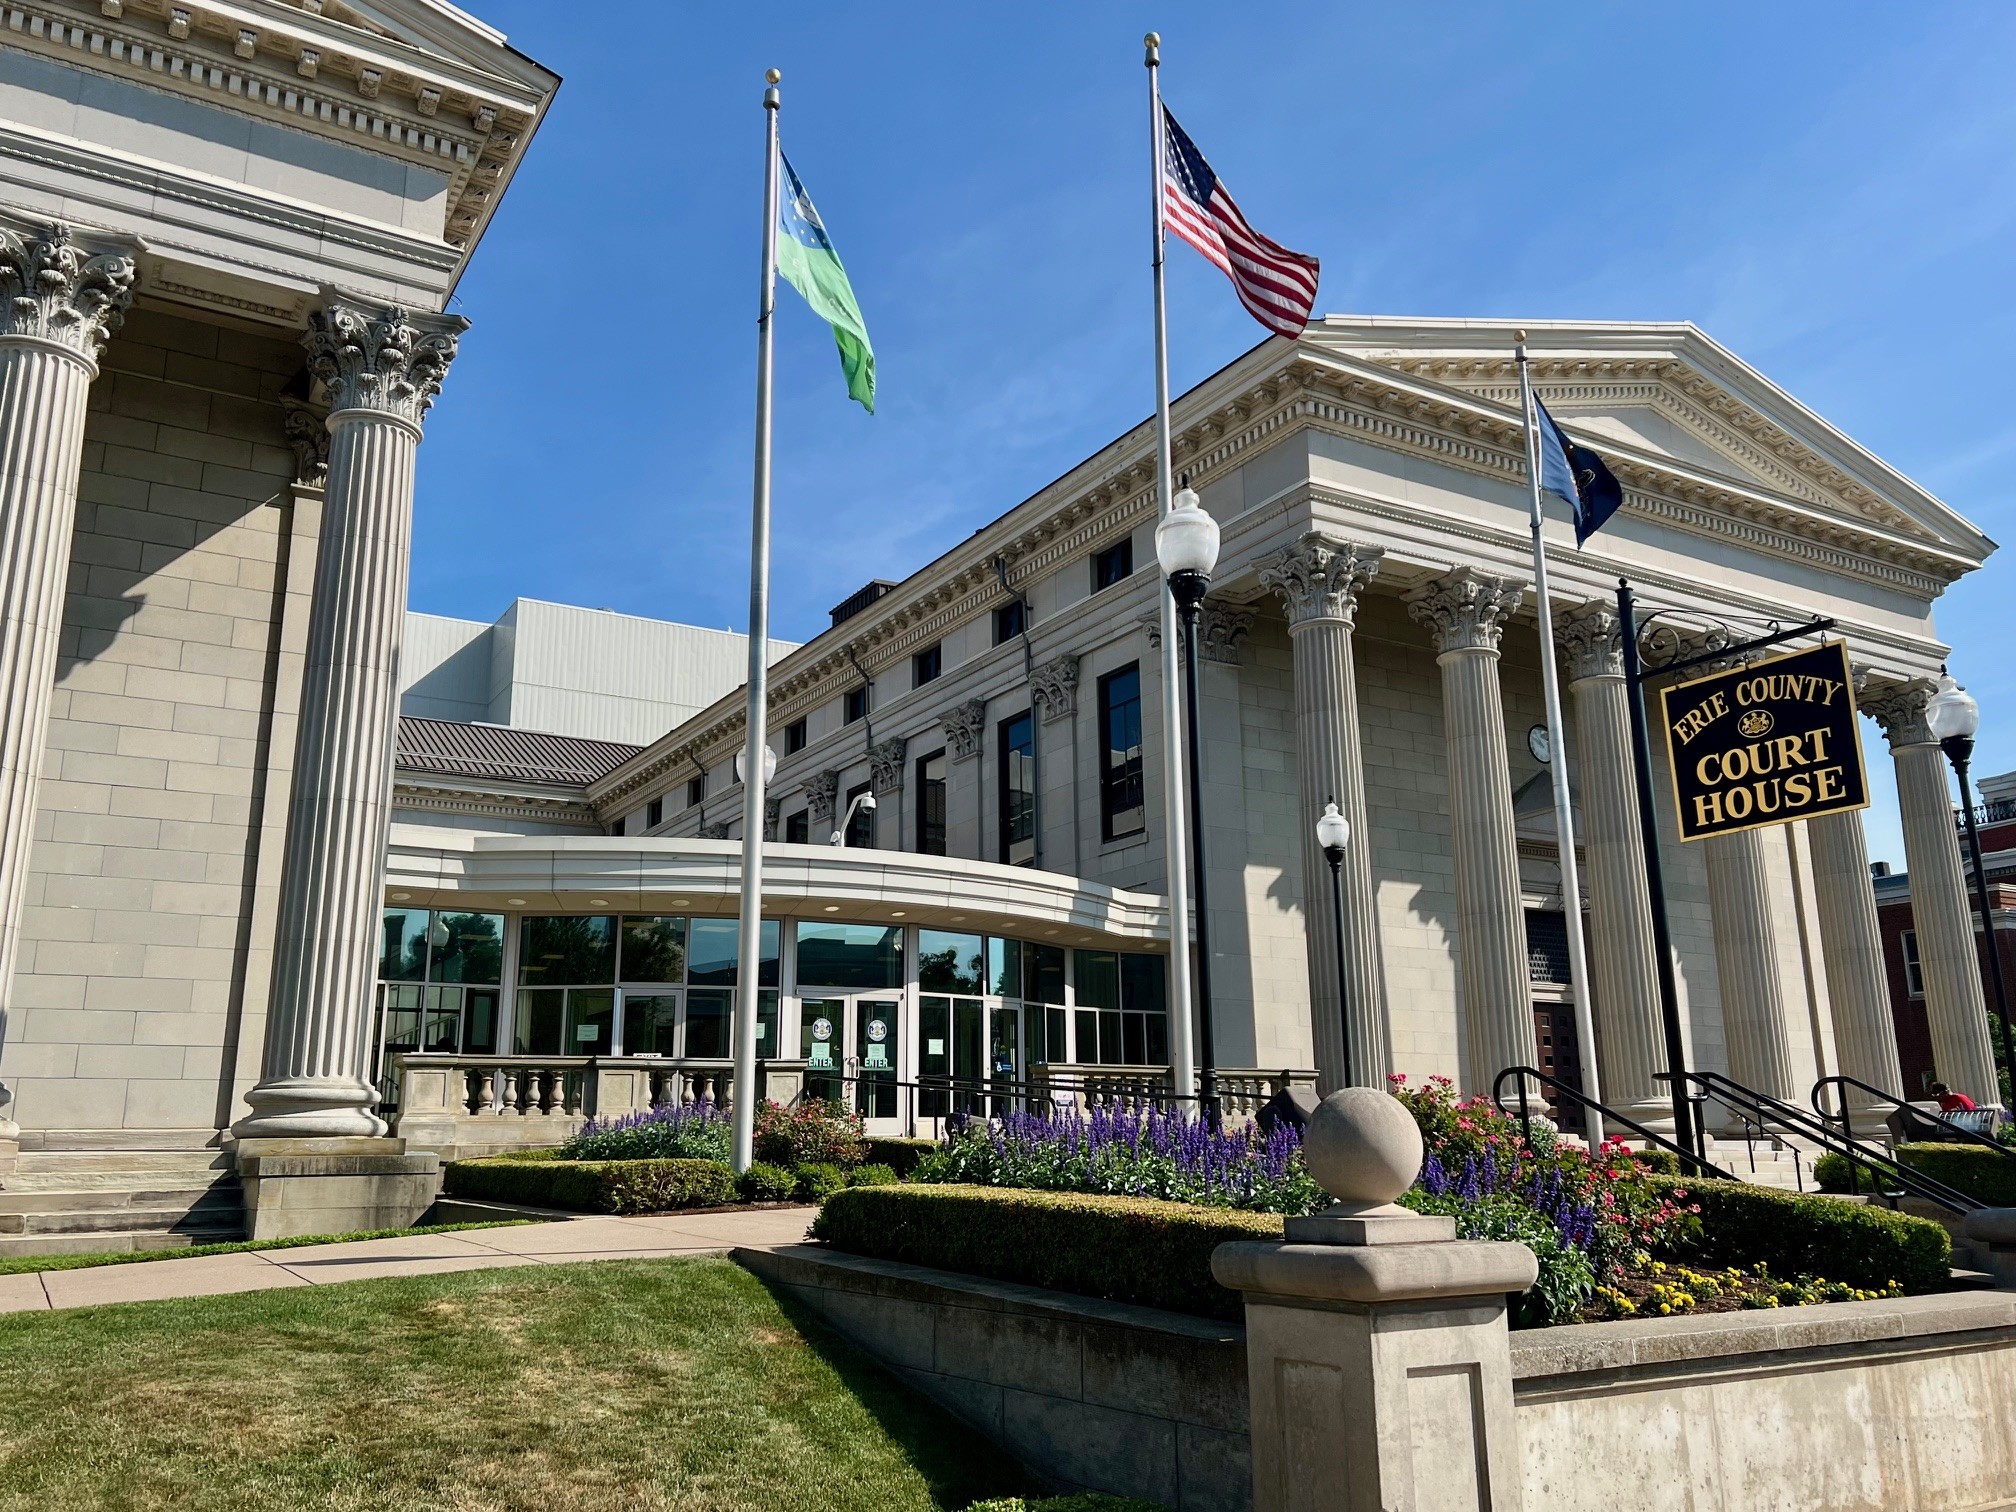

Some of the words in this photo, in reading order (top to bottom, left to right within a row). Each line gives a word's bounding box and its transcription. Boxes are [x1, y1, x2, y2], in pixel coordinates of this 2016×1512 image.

[1672, 690, 1730, 746] ERIE
[1736, 674, 1844, 706] COUNTY
[1696, 726, 1832, 786] COURT
[1692, 765, 1847, 827] HOUSE
[808, 1056, 833, 1067] ENTER
[864, 1057, 888, 1068] ENTER
